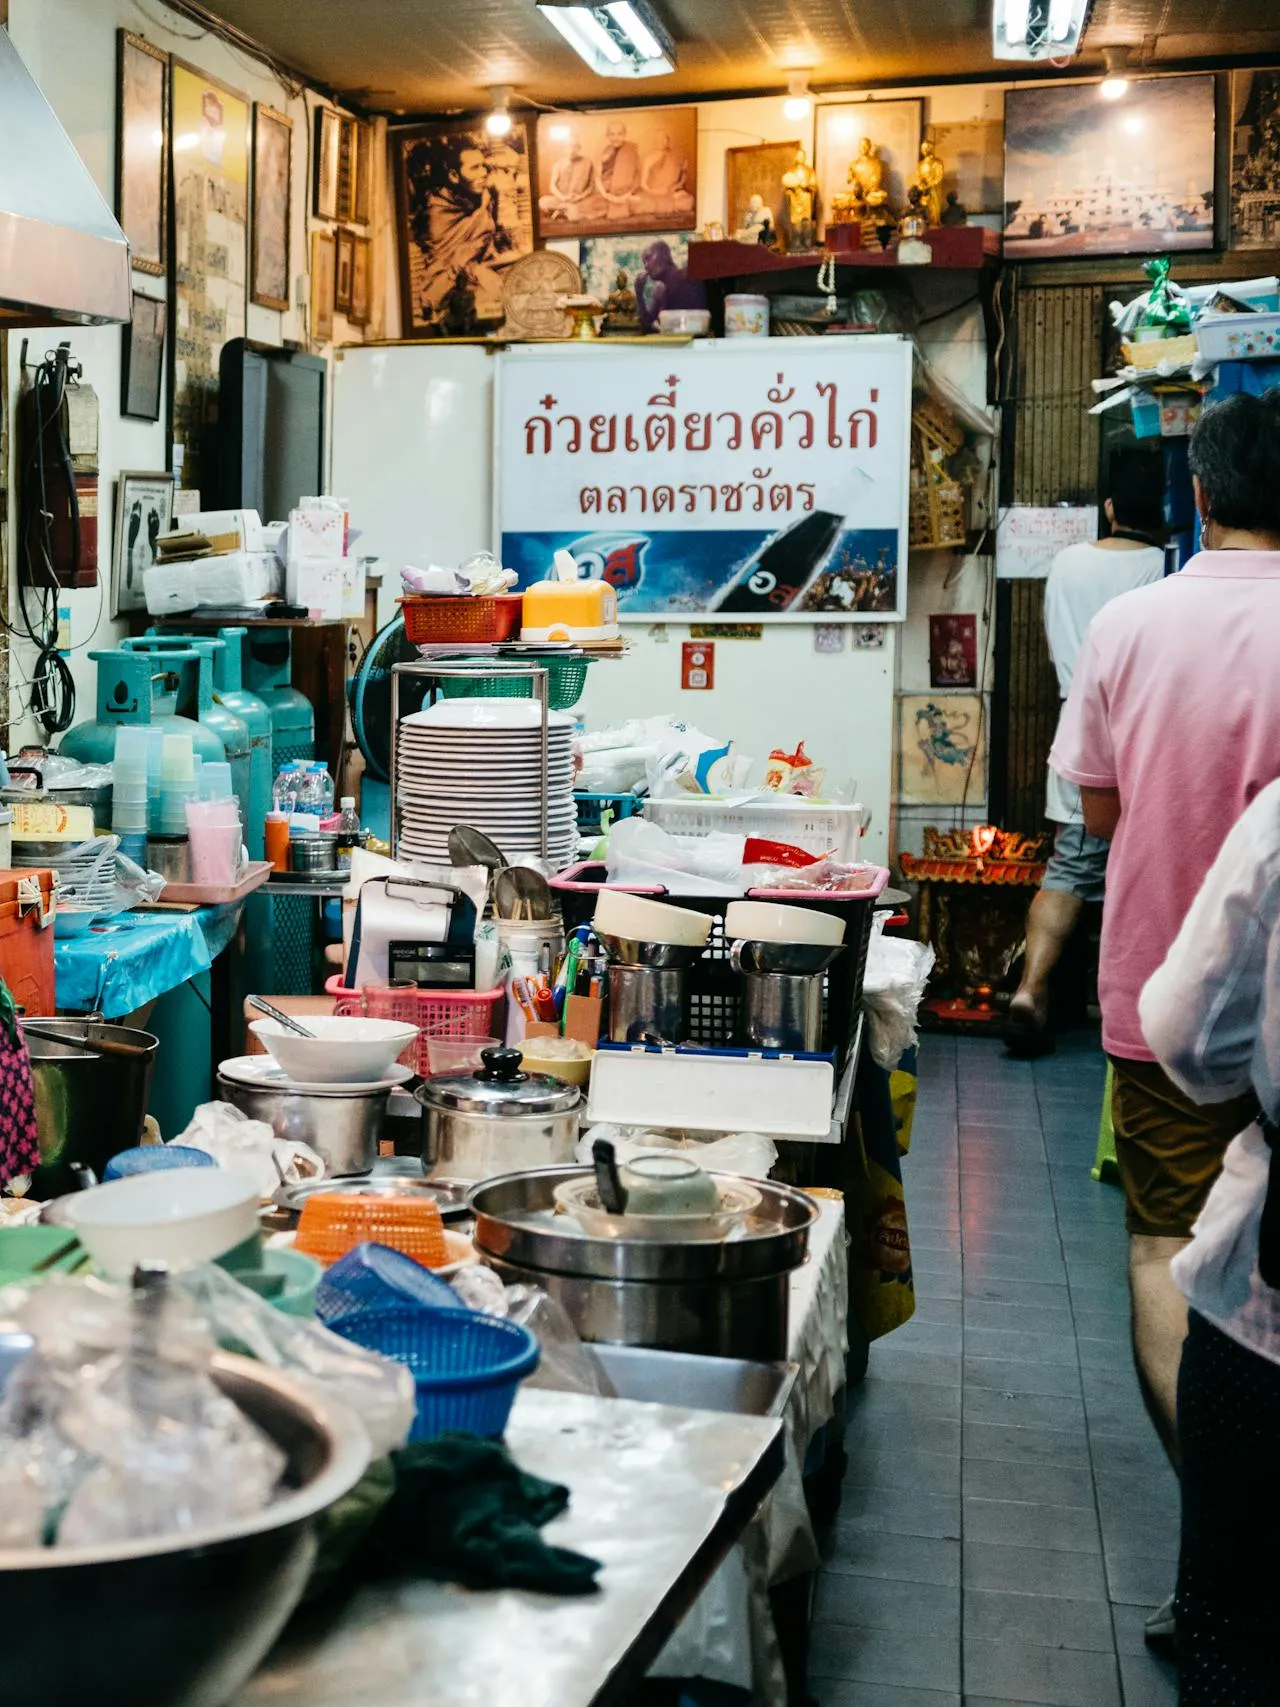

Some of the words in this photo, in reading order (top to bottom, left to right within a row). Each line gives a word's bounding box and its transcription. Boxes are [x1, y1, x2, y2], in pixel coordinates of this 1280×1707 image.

[524, 372, 880, 455] ก๋วยเตี๋ยวคั่วไก่
[578, 466, 817, 514] ตลาดราชวัตร
